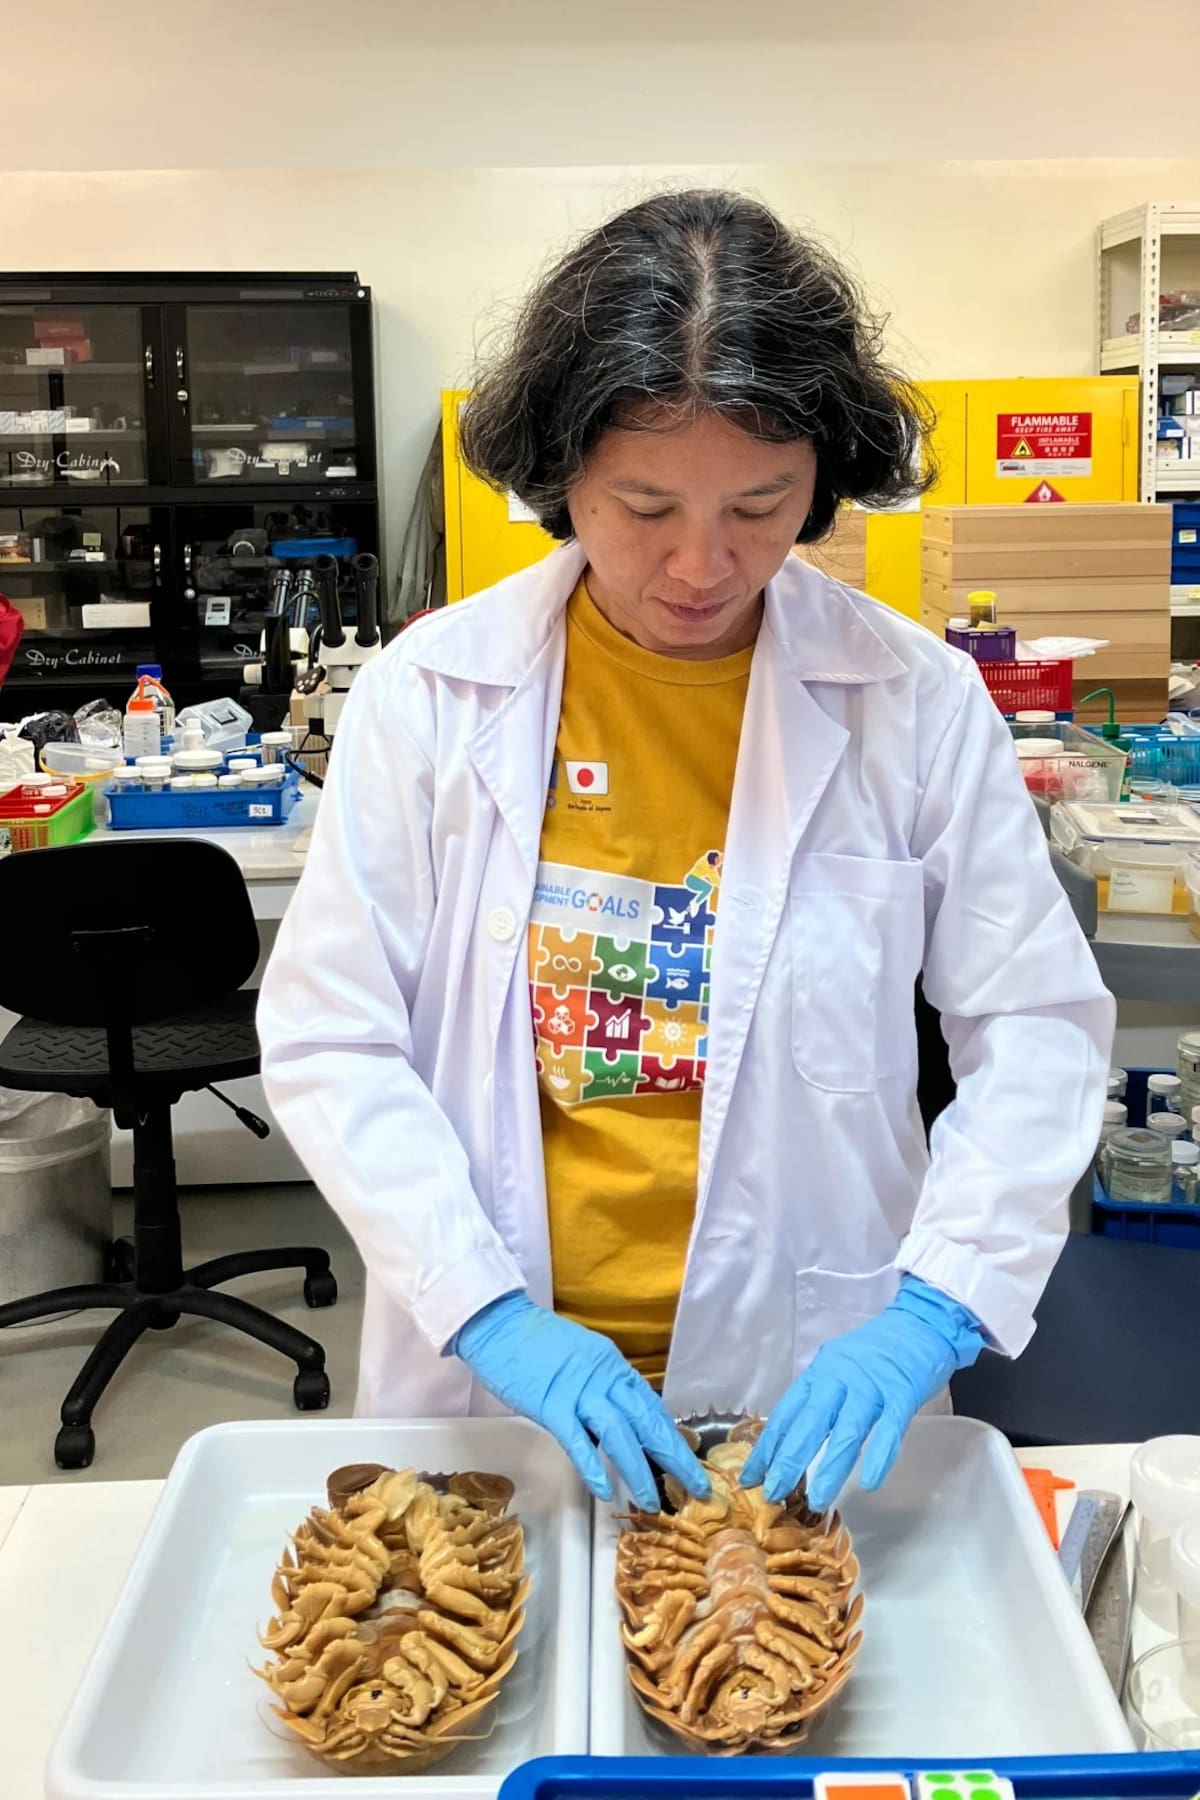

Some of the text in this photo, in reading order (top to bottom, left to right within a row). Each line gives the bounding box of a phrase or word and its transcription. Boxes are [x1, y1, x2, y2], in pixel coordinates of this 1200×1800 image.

[1011, 416, 1079, 427] FLAMMABLE
[25, 649, 121, 669] Dry-Cabinet
[1068, 760, 1110, 768] NALGENE
[572, 889, 640, 919] GOALS
